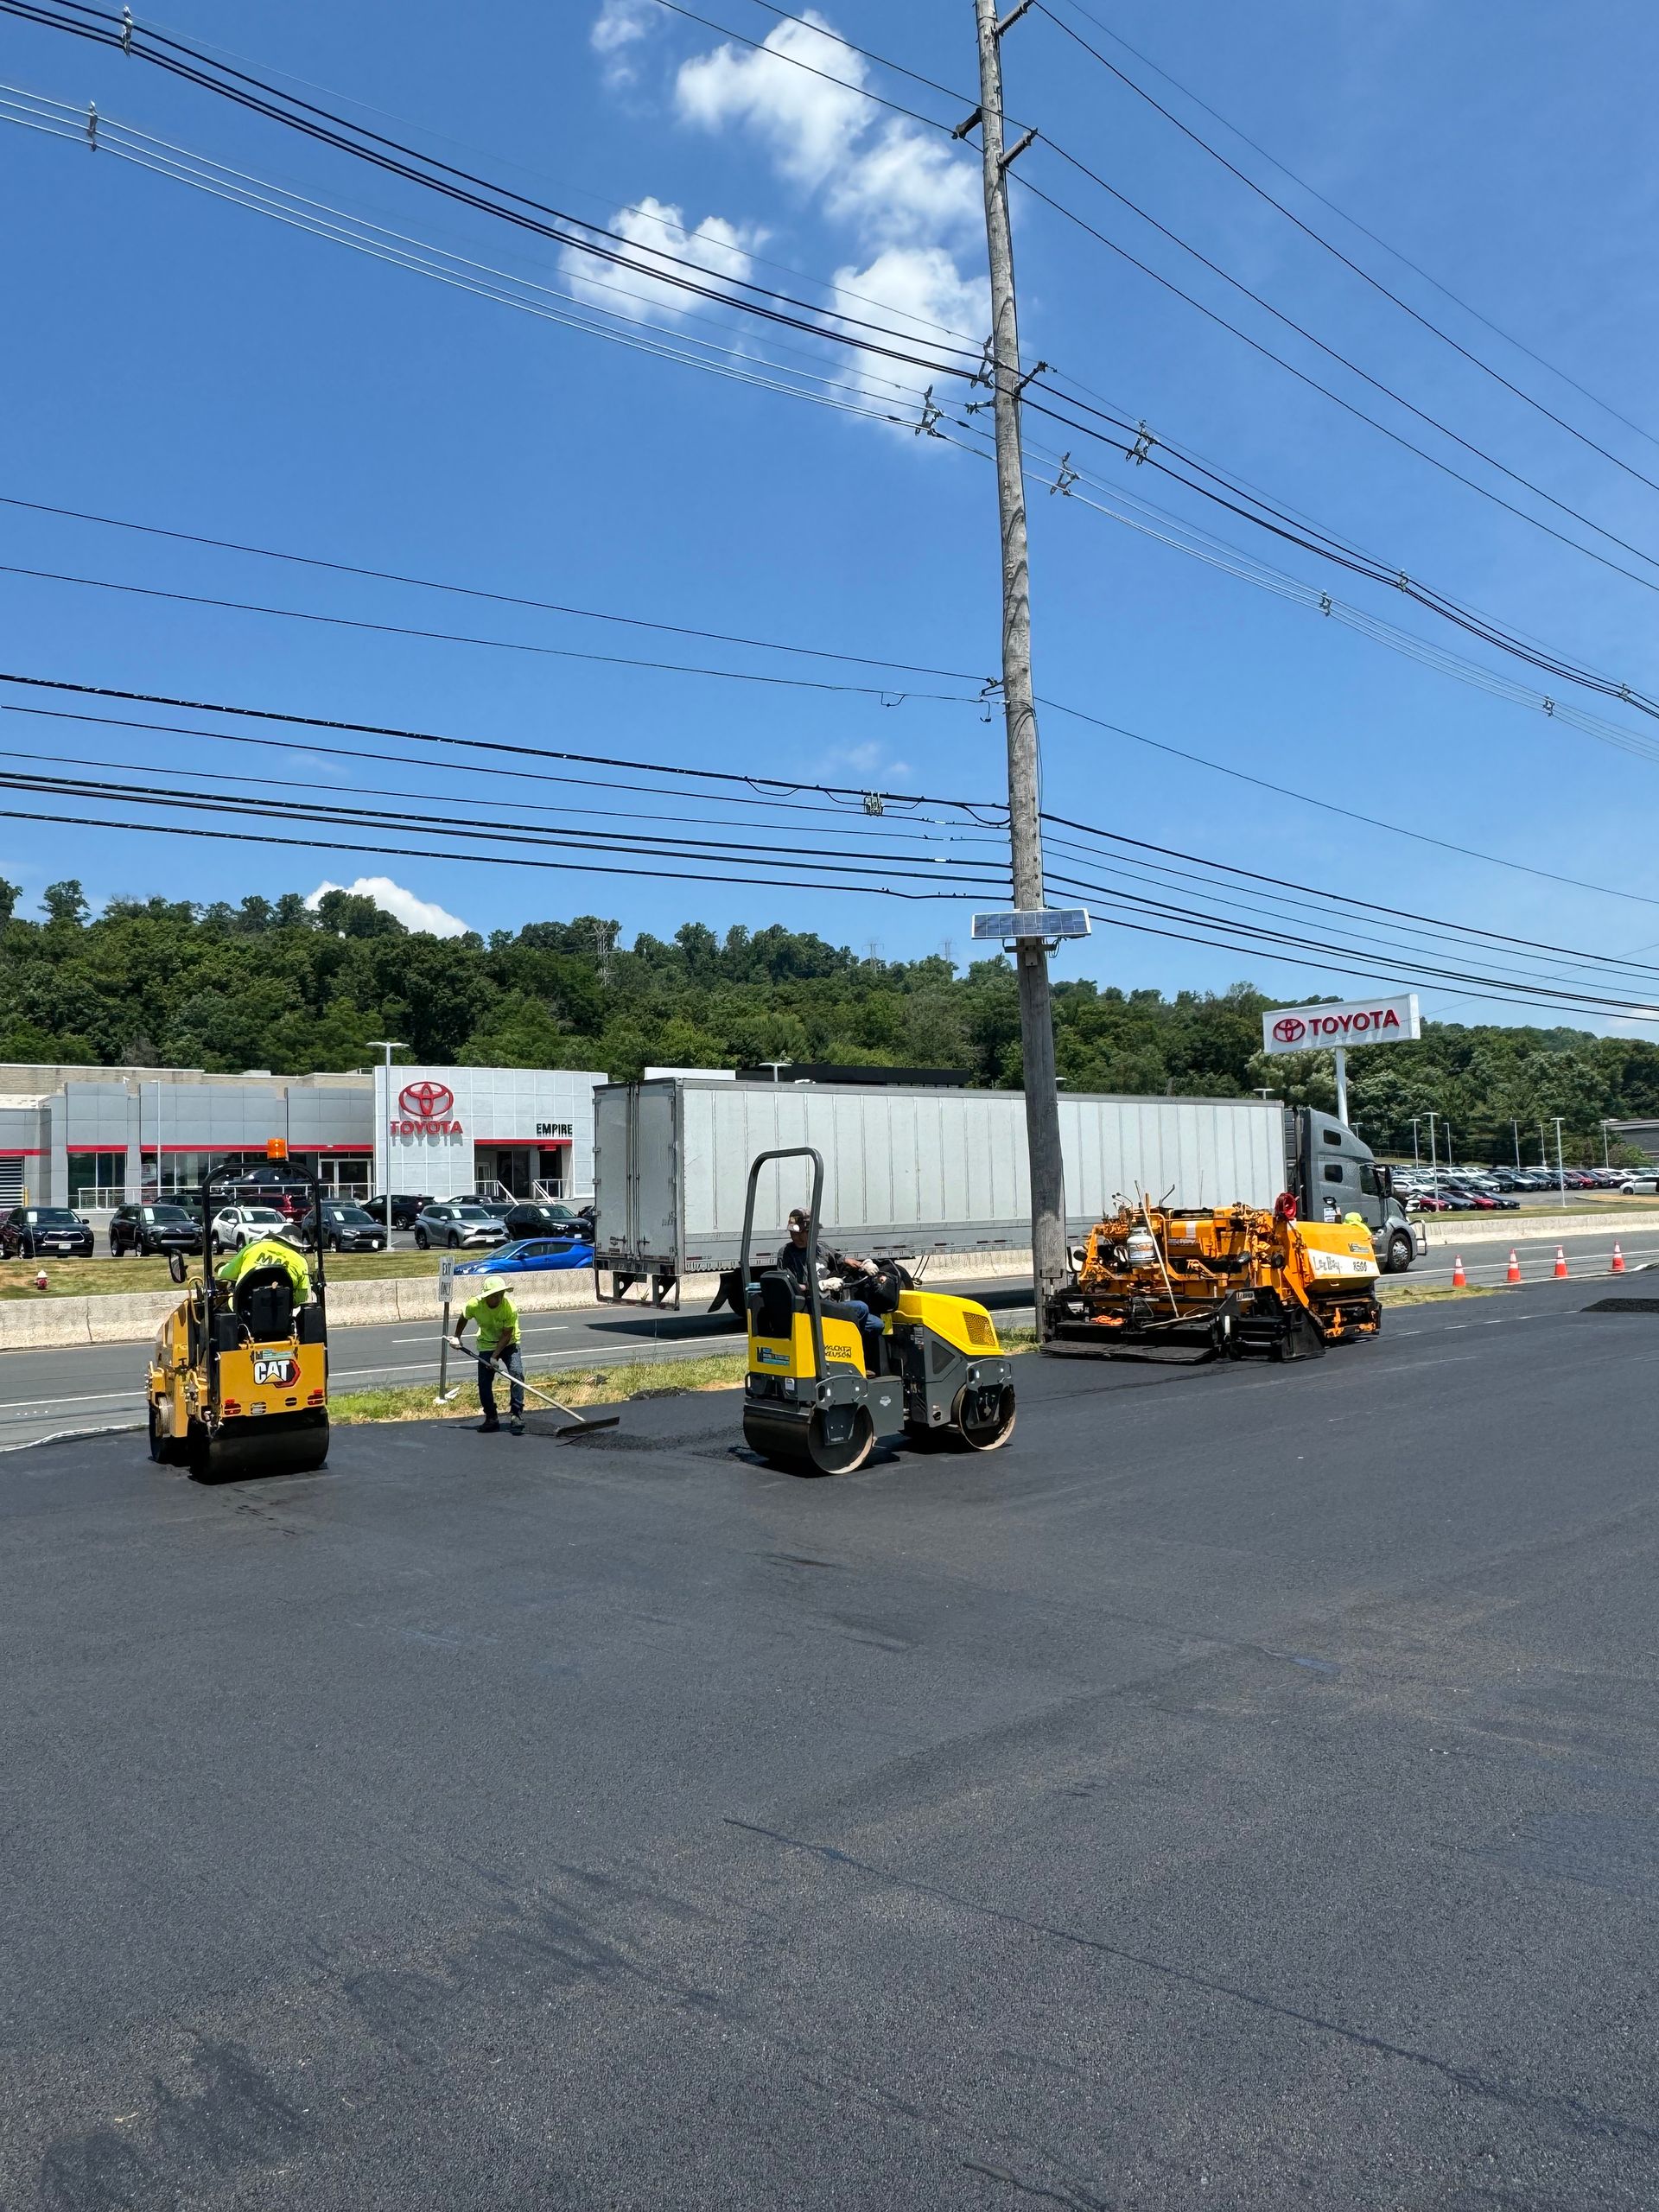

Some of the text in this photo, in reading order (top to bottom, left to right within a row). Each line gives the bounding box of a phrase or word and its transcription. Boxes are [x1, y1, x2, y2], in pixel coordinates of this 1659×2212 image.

[1309, 1009, 1399, 1036] TOYOTA
[390, 1121, 463, 1135] TOYOTA
[536, 1123, 573, 1135] EMPIRE
[254, 1359, 290, 1384] CAT
